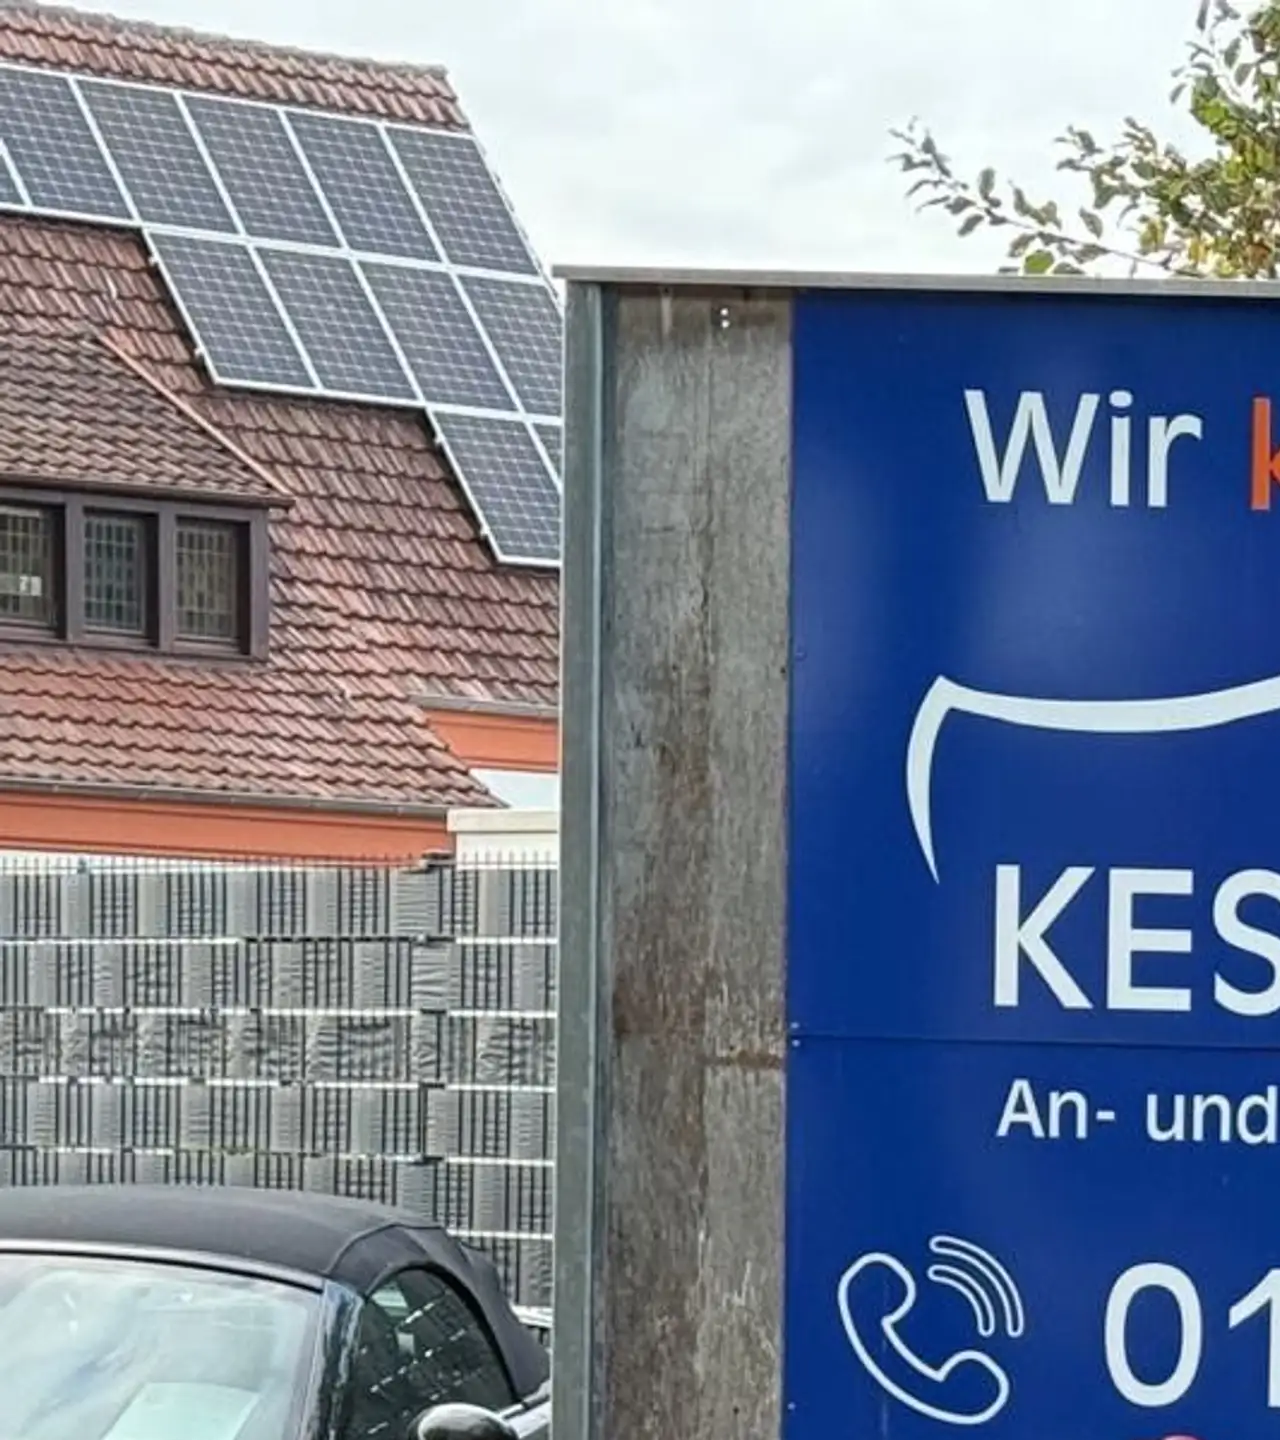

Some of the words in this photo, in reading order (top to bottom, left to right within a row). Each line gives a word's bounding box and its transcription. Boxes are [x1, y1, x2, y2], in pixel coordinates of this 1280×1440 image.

[964, 389, 1202, 508] Wir
[997, 1079, 1115, 1139] An-
[1147, 1085, 1278, 1144] und
